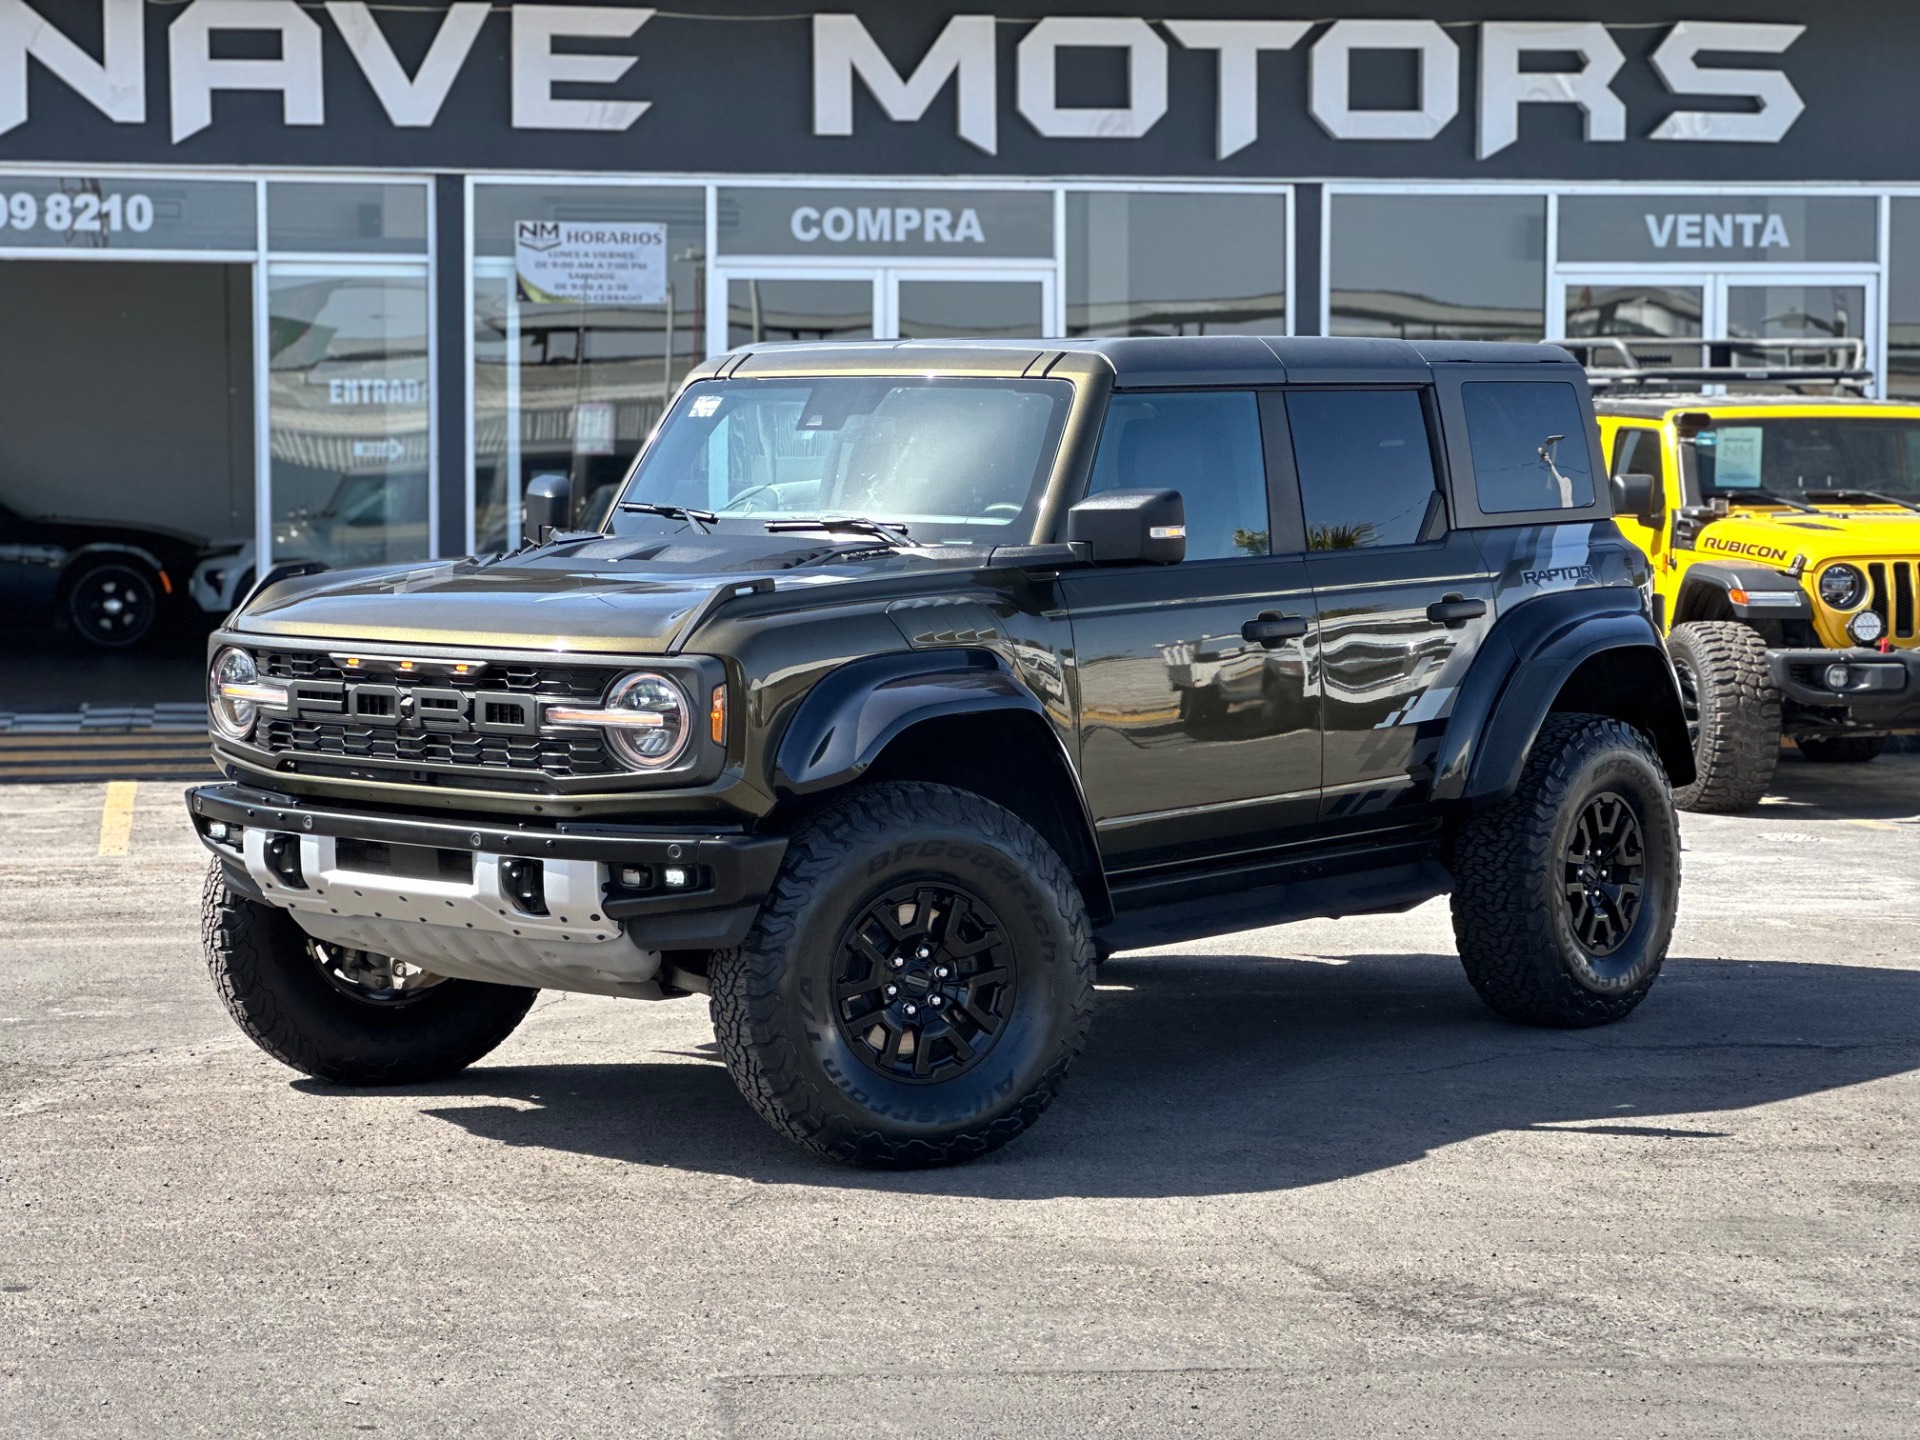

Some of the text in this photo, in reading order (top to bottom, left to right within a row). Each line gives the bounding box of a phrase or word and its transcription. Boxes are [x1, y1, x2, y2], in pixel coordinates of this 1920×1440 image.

[0, 0, 1807, 160] NAVE MOTORS
[44, 192, 154, 232] 8210
[791, 207, 985, 243] COMPRA
[519, 222, 560, 239] NM
[566, 230, 663, 246] HORARIOS
[1645, 213, 1790, 249] VENTA
[1704, 537, 1787, 561] RUBICON
[1521, 564, 1599, 588] RAPTOR
[287, 678, 541, 735] FORD
